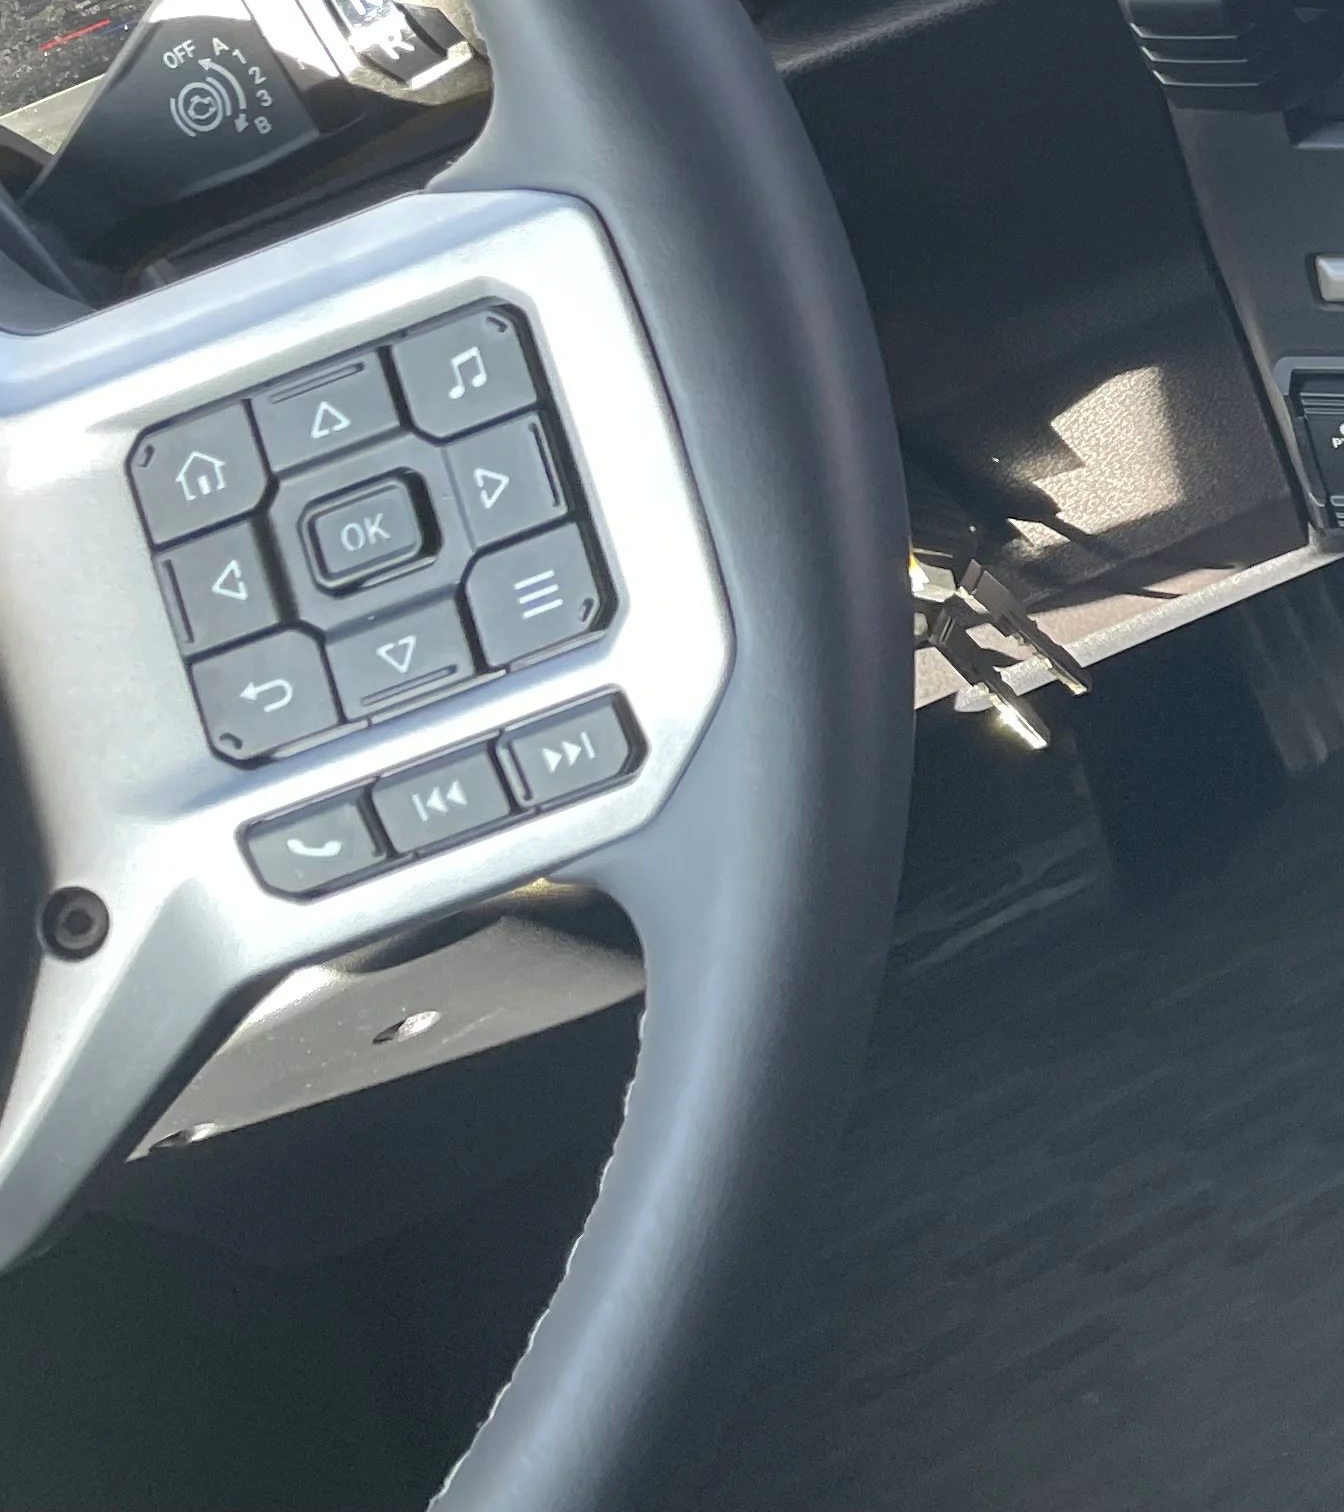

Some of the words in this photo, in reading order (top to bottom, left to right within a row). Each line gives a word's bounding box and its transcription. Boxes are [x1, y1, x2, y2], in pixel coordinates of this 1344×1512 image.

[163, 39, 196, 68] OFF
[212, 37, 231, 56] A
[232, 48, 248, 64] 1
[248, 66, 267, 85] 2
[256, 90, 272, 107] 3
[254, 116, 272, 134] B
[340, 513, 391, 552] OK
